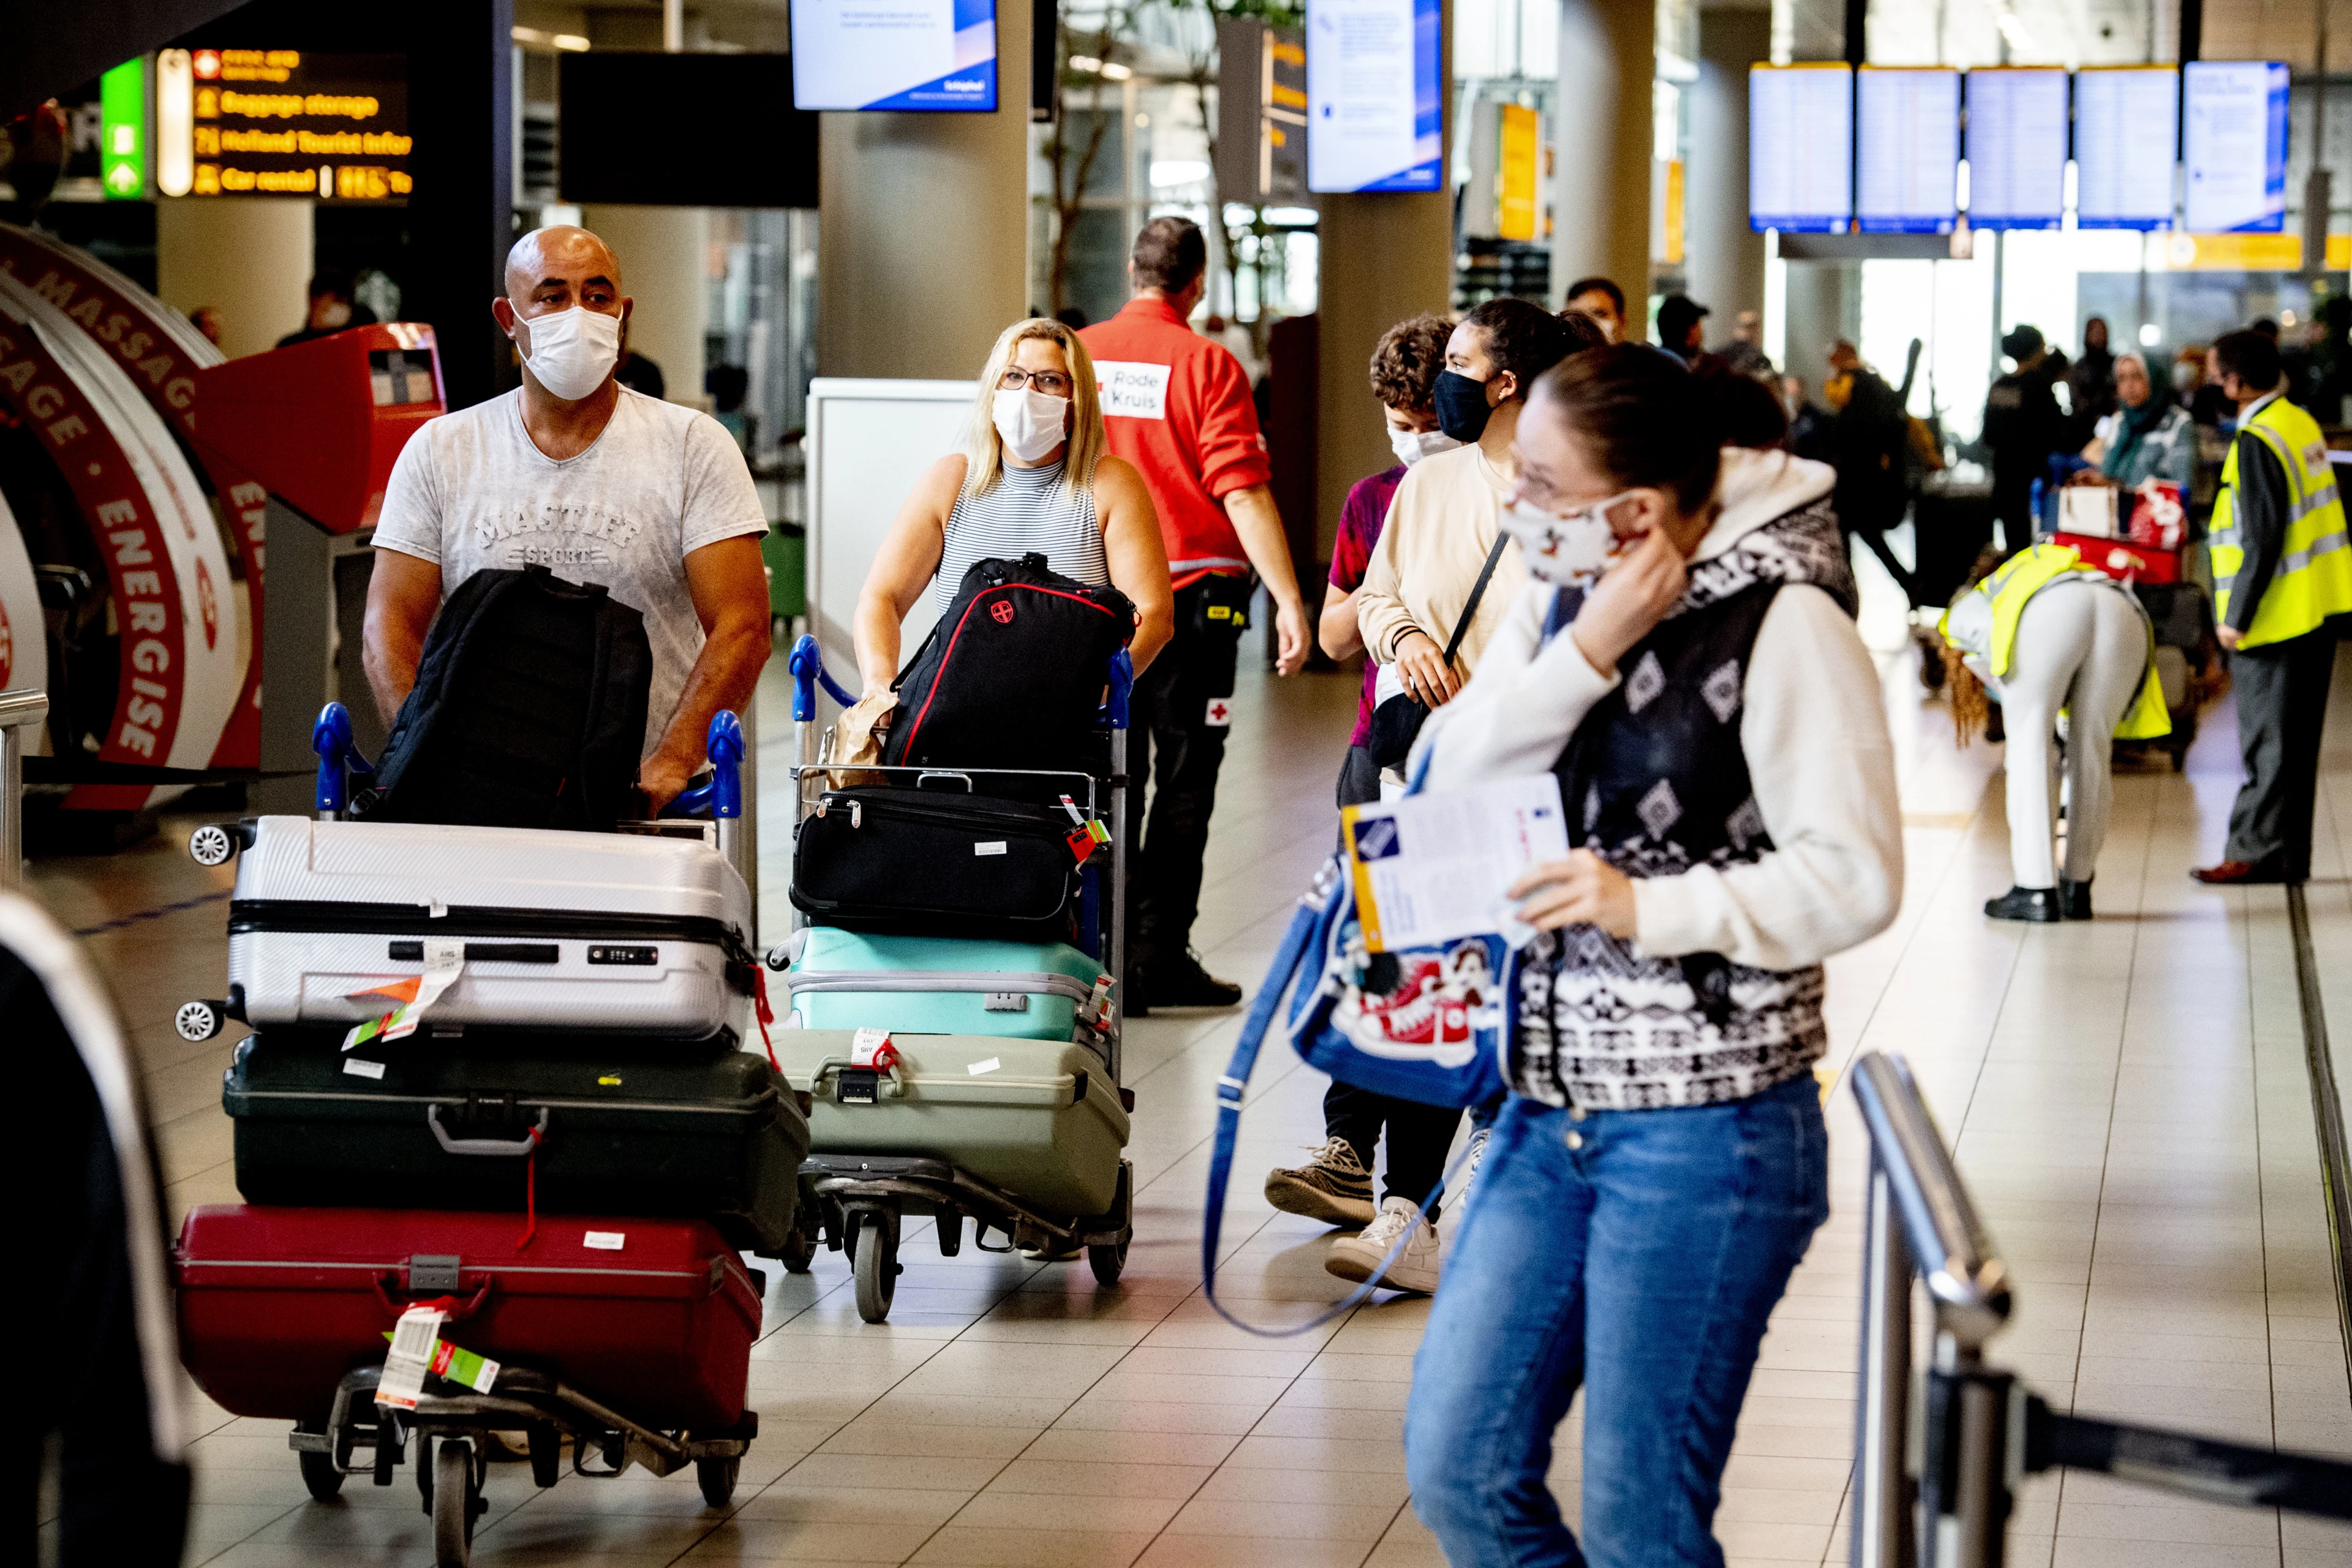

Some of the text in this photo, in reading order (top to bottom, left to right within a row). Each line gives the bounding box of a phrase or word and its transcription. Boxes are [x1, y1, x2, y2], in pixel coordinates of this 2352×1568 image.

[1114, 371, 1158, 387] Rode
[1112, 390, 1156, 409] Kruis
[474, 502, 642, 548] MASTIFF
[524, 547, 590, 564] SPORT
[96, 499, 169, 758] ENERGISE
